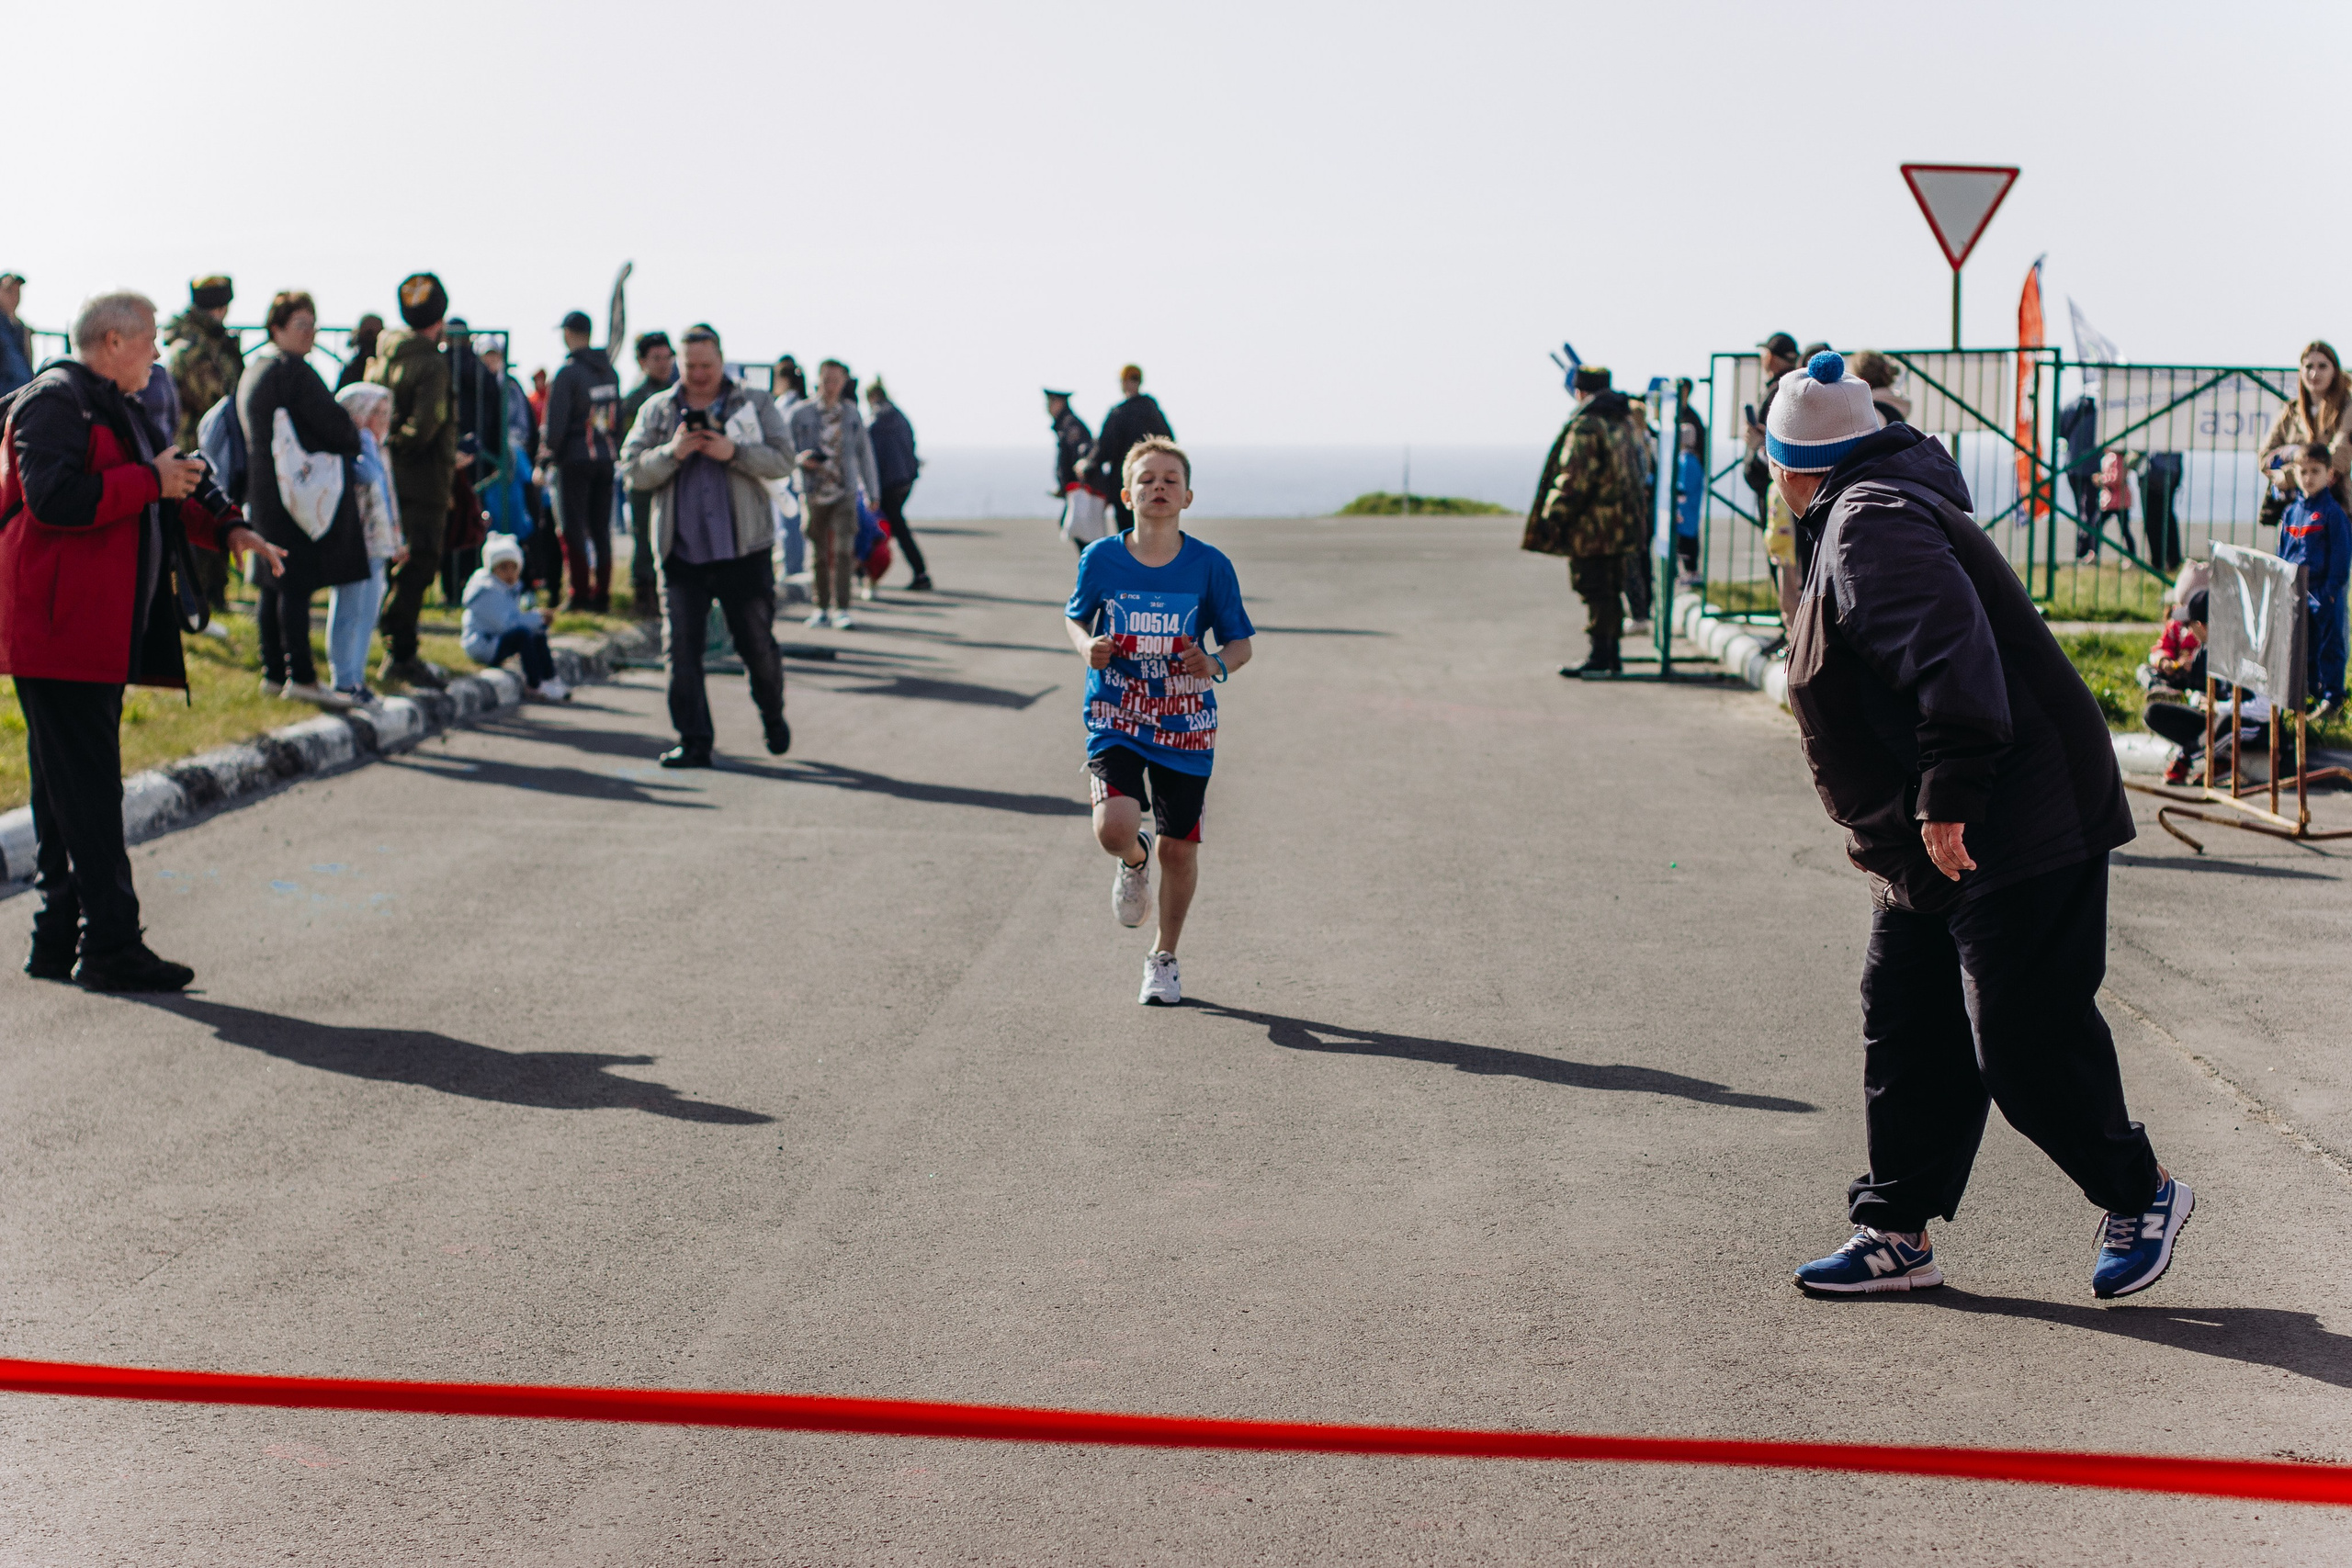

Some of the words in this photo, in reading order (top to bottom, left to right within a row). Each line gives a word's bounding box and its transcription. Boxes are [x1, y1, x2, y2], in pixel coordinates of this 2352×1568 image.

[1129, 611, 1180, 634] 00514
[1140, 660, 1187, 679] #ЗАБЕ
[1121, 691, 1204, 716] #ГОРДОСТЬ
[1185, 708, 1216, 730] 2024
[1863, 1247, 1897, 1278] N
